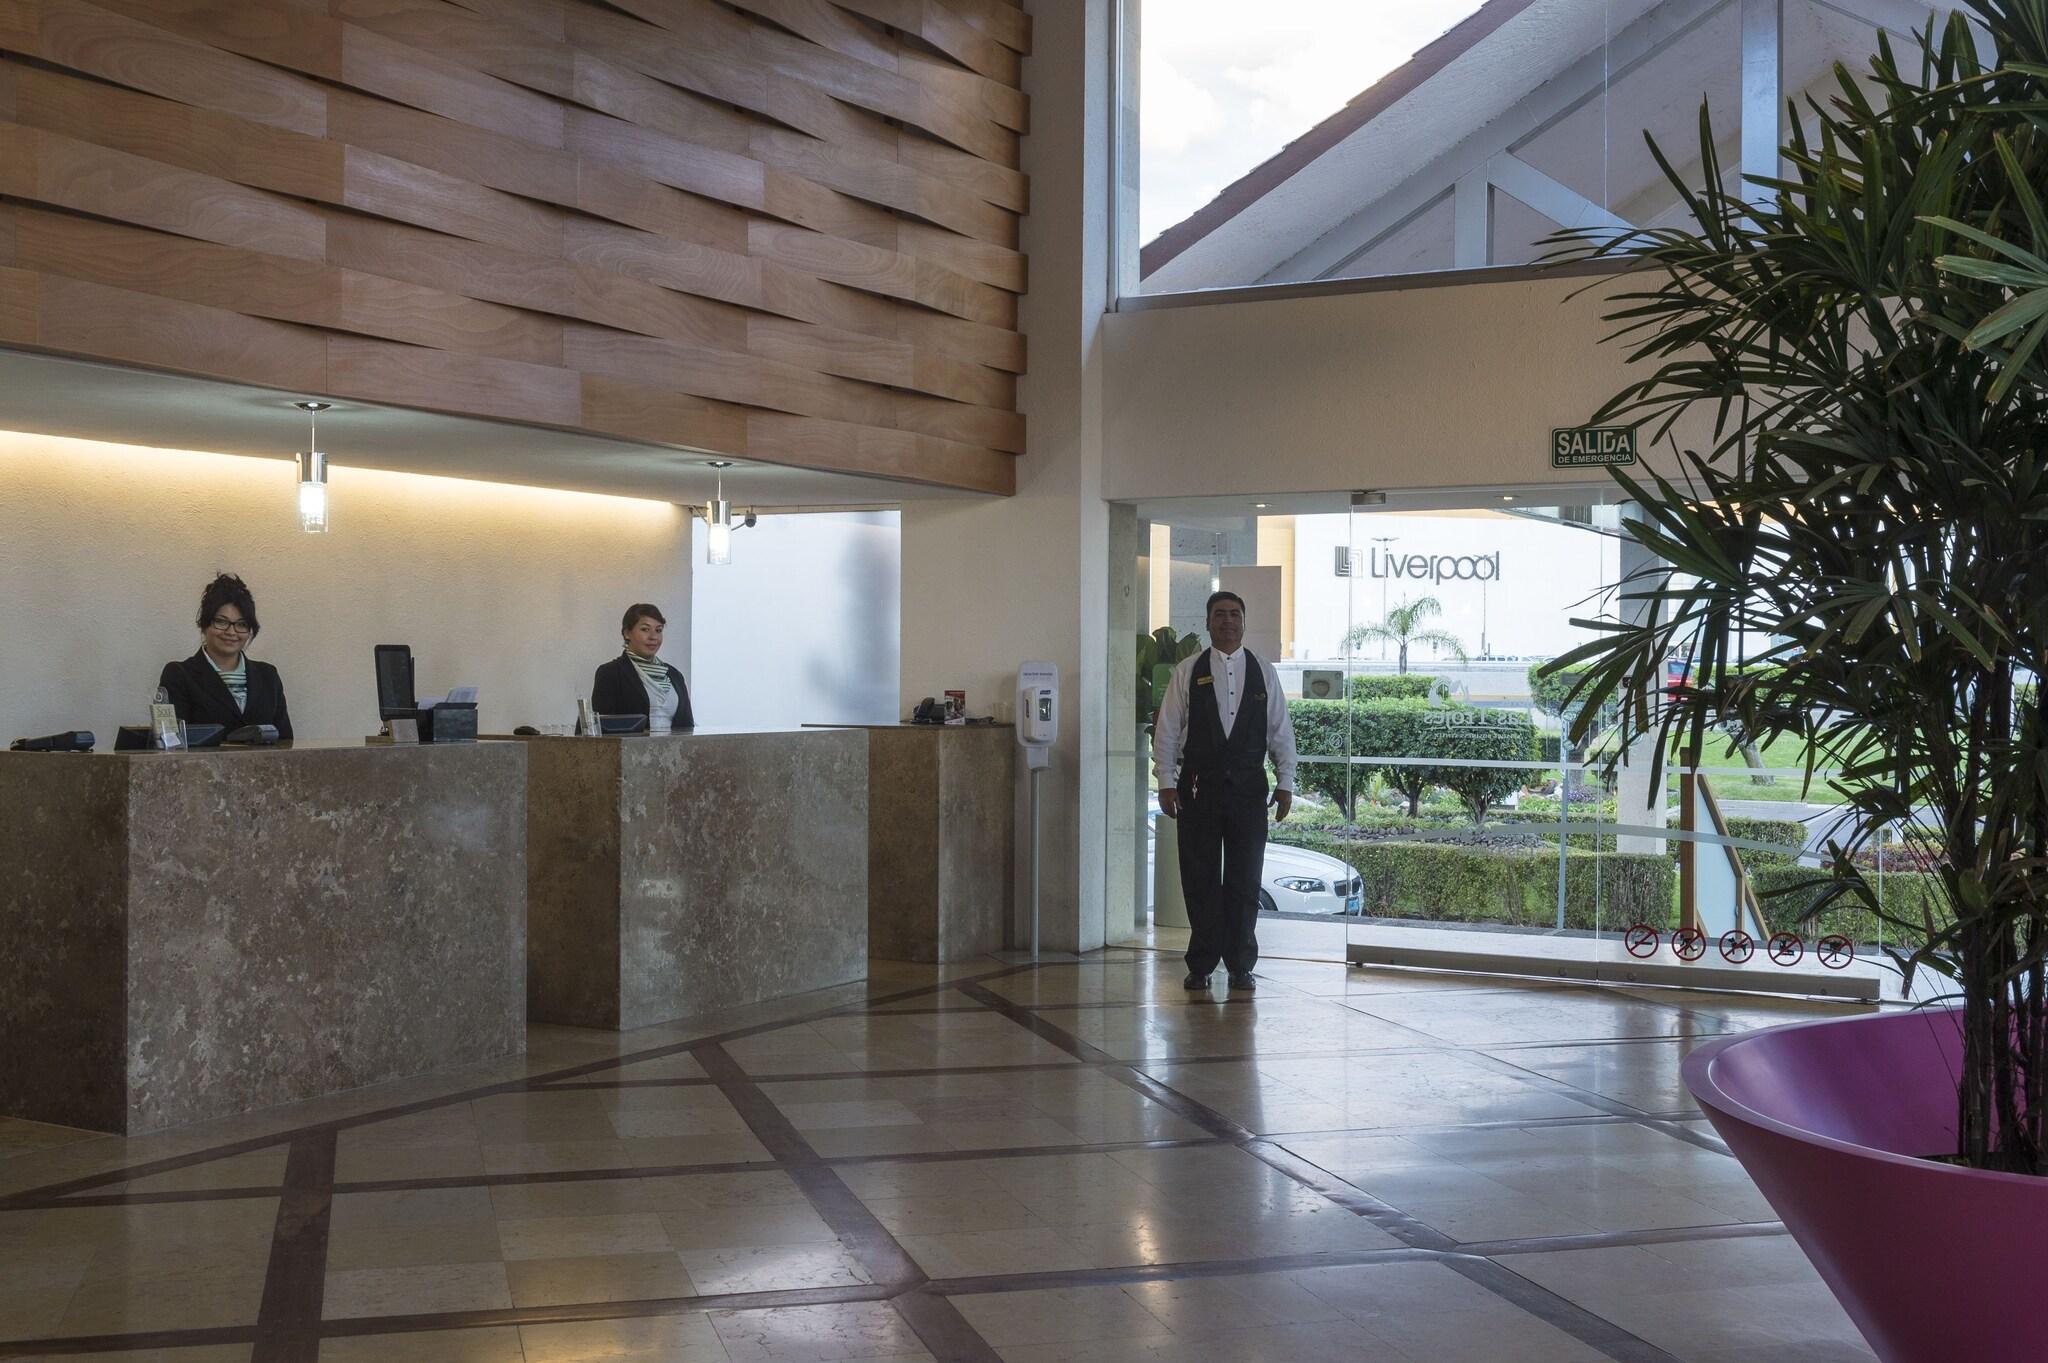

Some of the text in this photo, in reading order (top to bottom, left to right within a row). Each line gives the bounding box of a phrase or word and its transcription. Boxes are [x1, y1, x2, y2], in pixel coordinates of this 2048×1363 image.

[1557, 431, 1631, 455] SALIDA
[1558, 453, 1632, 464] DE EMERGENCIA
[1371, 547, 1500, 586] Liverpool
